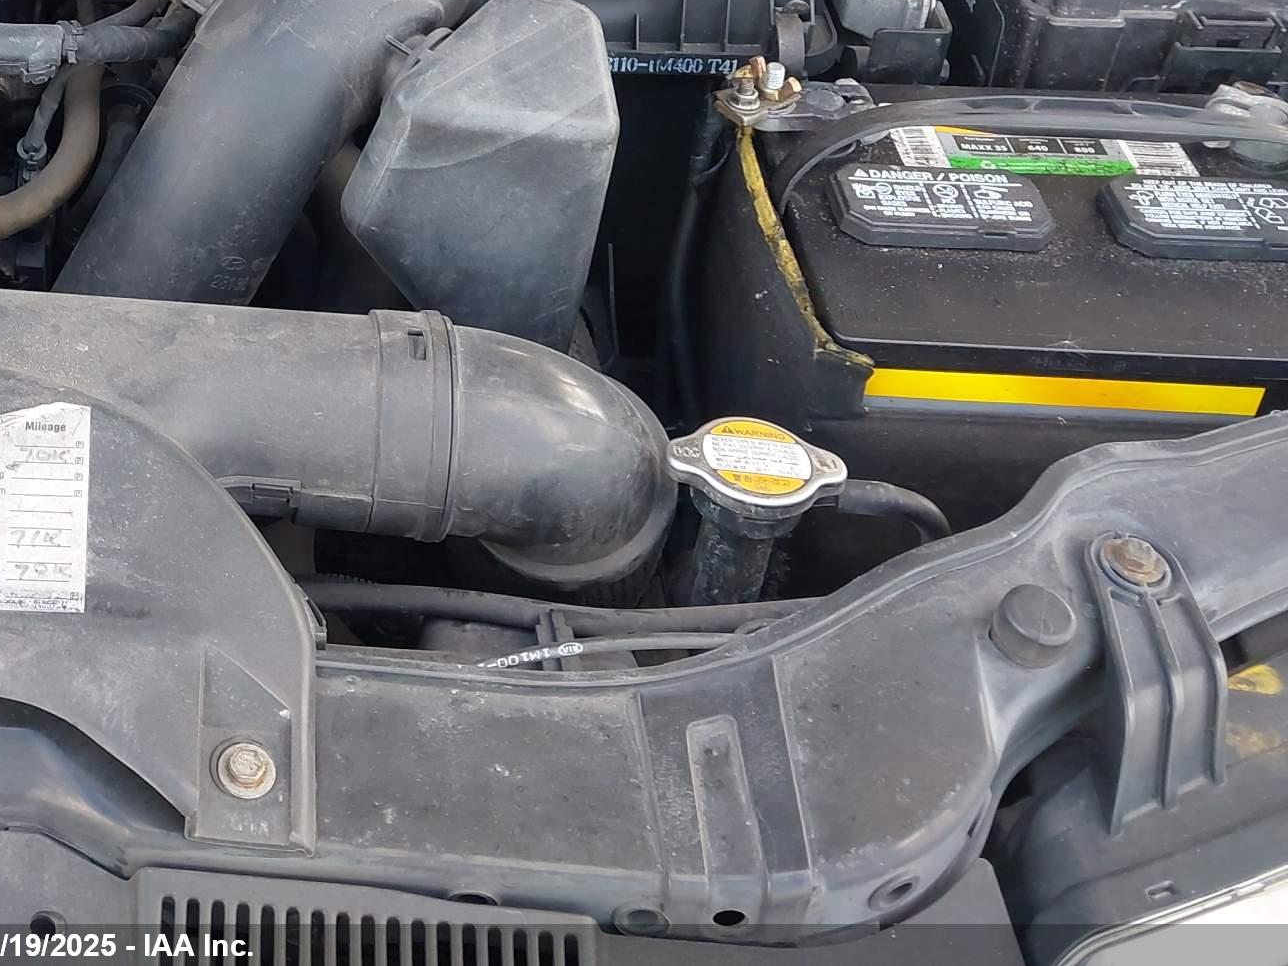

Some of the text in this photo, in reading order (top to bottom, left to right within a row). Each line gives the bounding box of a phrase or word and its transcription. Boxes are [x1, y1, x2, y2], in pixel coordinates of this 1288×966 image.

[868, 169, 934, 181] DANGER
[948, 173, 1009, 184] POISON
[25, 421, 66, 433] Mileage
[734, 428, 787, 441] WARNING
[560, 643, 582, 654] KIA
